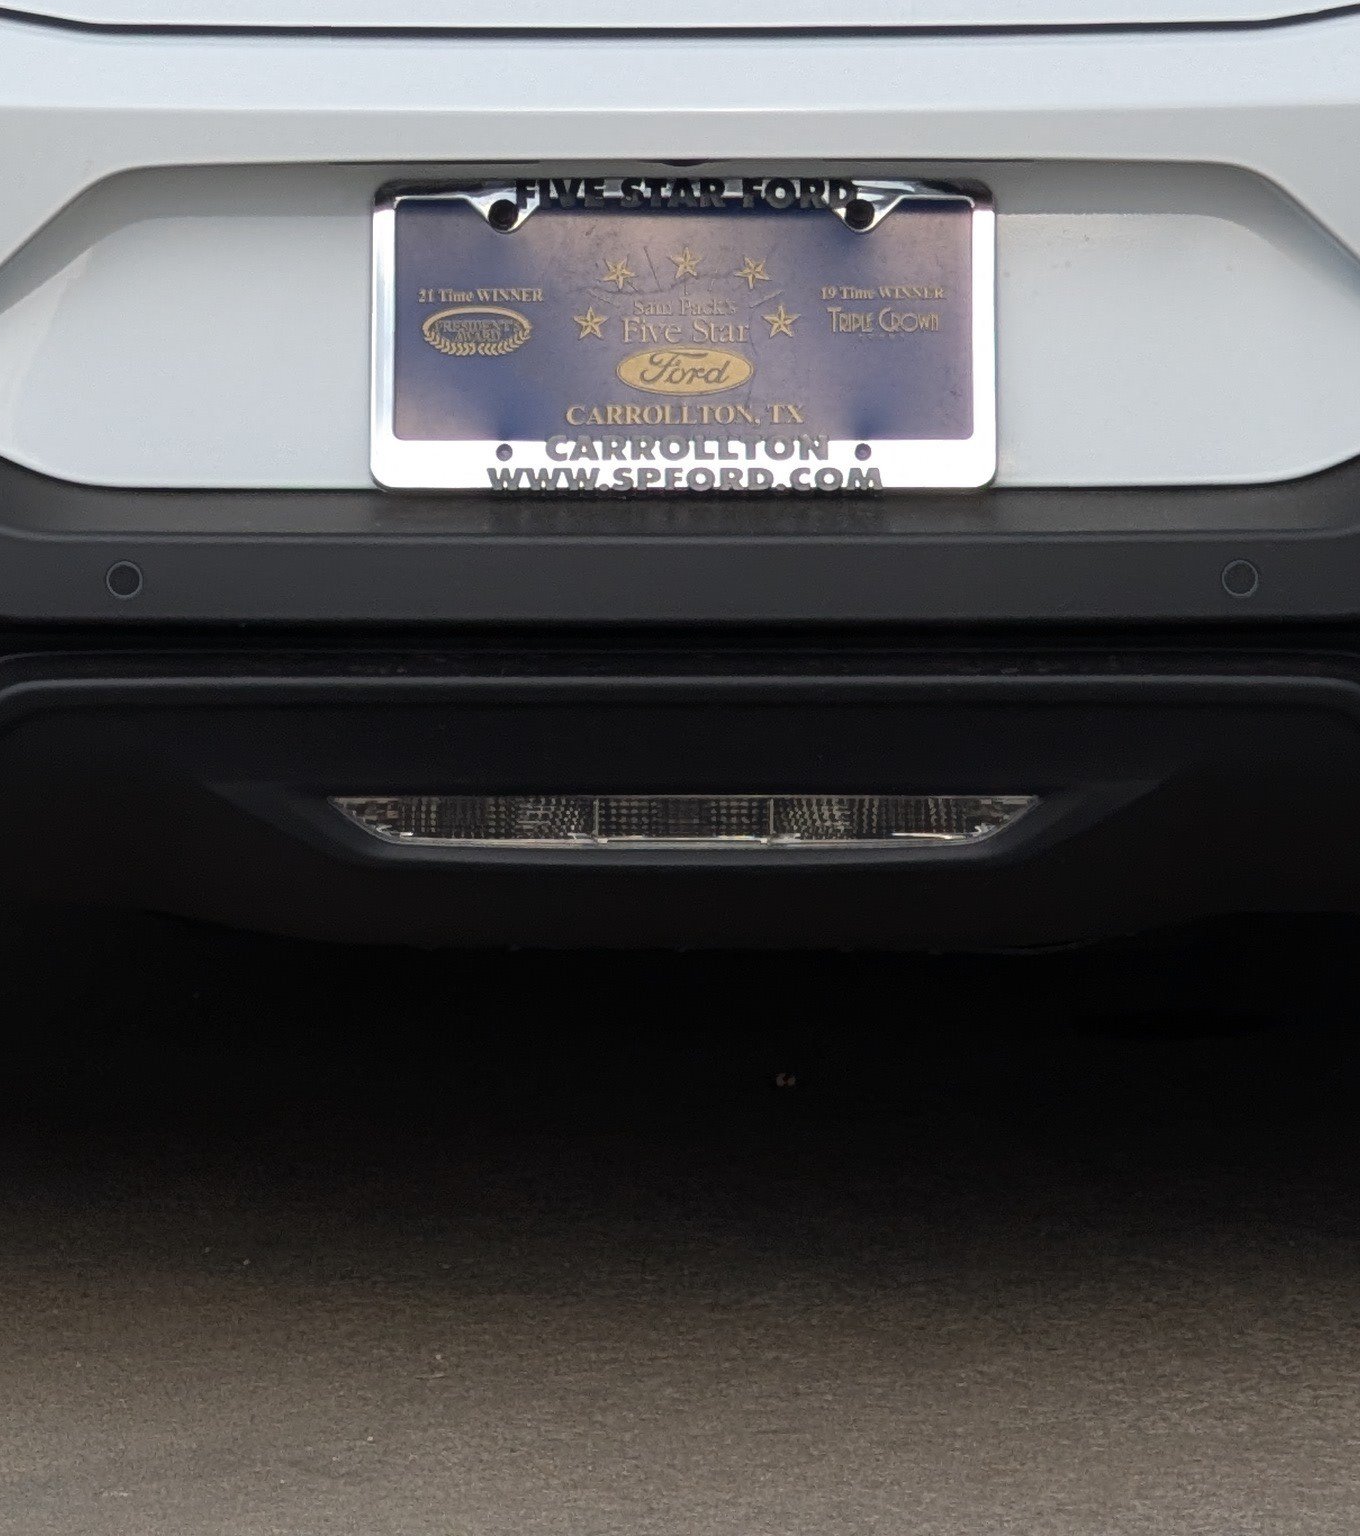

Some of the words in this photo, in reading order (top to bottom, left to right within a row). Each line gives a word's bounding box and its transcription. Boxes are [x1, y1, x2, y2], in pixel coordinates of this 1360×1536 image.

[516, 178, 604, 209] FIVE
[621, 178, 726, 209] STAR
[741, 178, 857, 209] FORD
[438, 288, 475, 303] Time
[476, 288, 544, 303] WINNER
[622, 315, 683, 344] Five
[691, 315, 751, 344] Star
[640, 351, 732, 385] Ford
[768, 404, 805, 425] TX
[545, 433, 830, 462] CARROLLTON
[486, 466, 883, 492] WWW.SPFORD.COM
